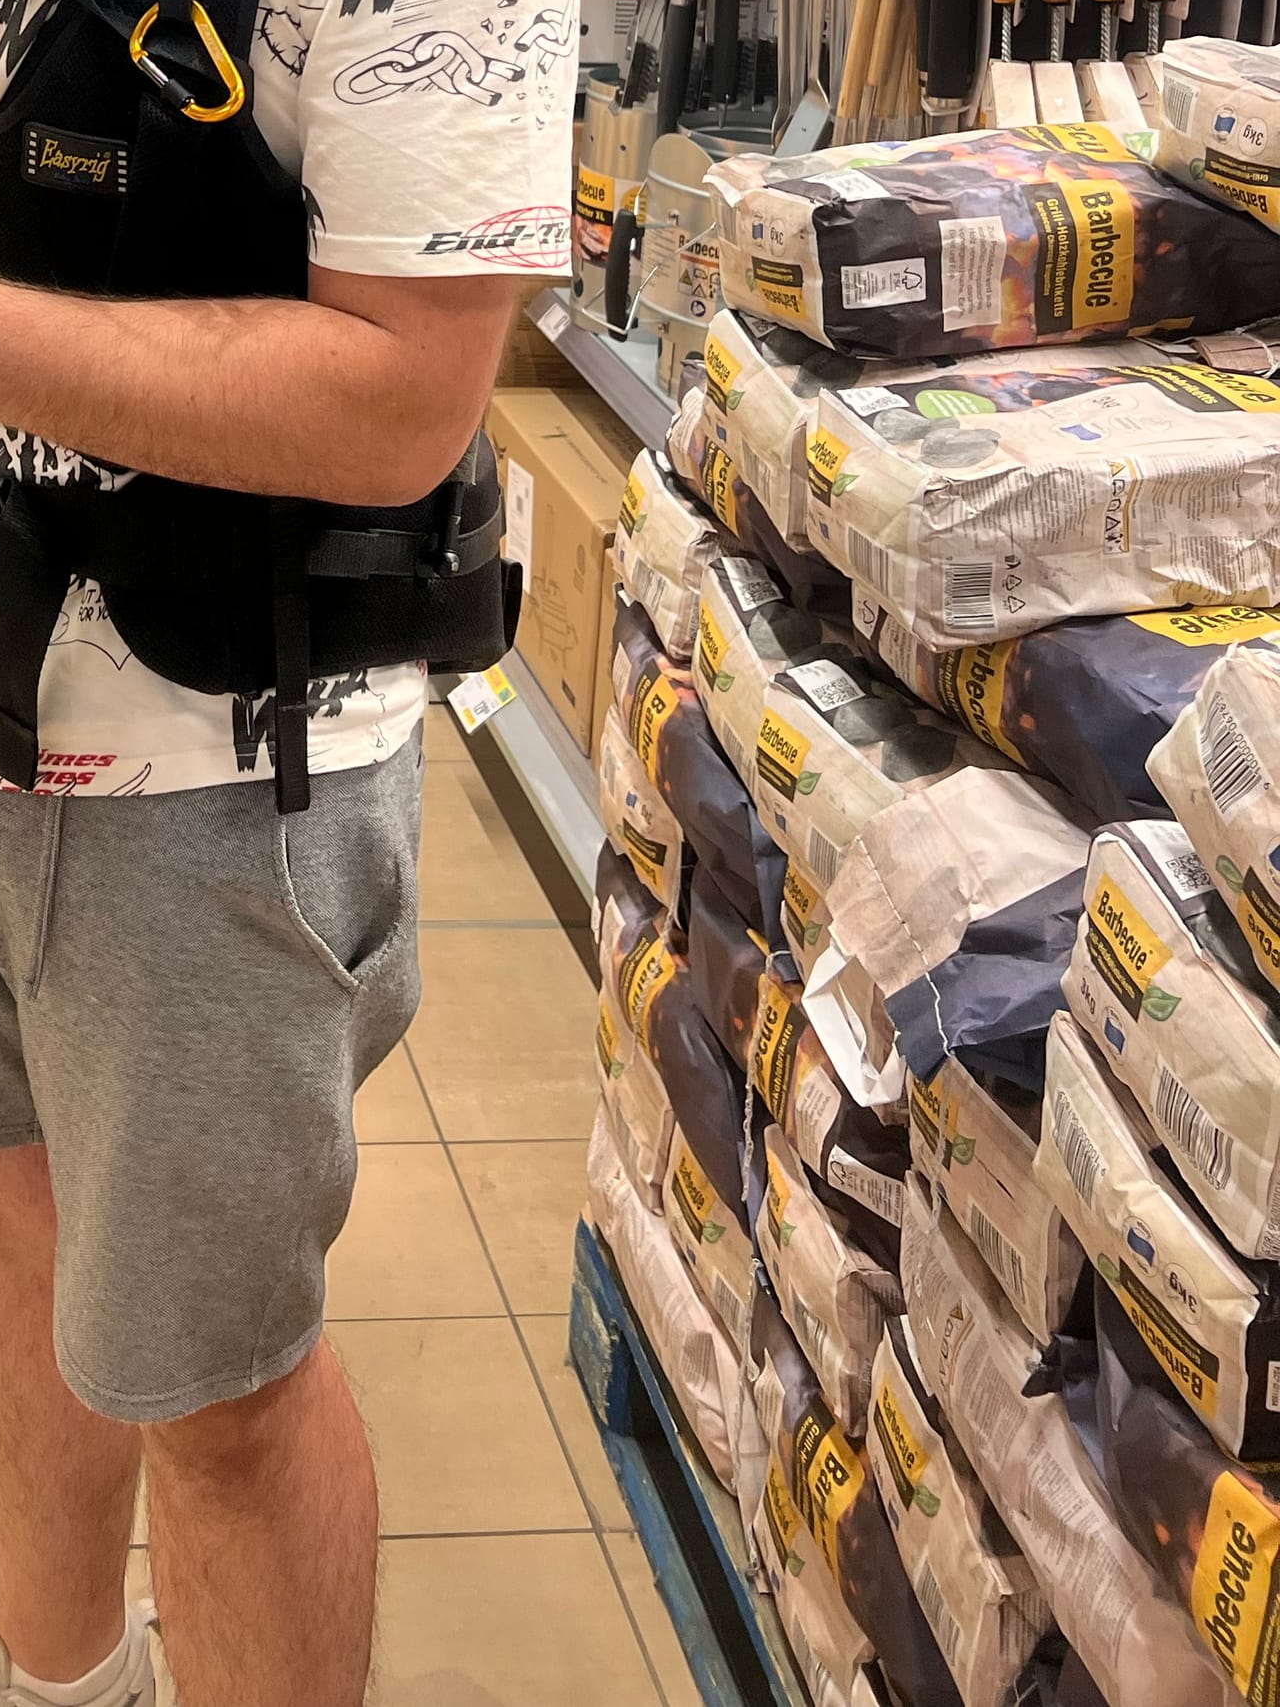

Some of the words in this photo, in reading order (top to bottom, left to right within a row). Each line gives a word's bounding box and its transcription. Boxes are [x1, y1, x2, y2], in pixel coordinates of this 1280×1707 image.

[1242, 123, 1264, 147] 3kg
[39, 137, 111, 183] Easyrig
[1079, 190, 1121, 309] Barbecue
[759, 717, 798, 765] Barbecue
[1096, 890, 1147, 972] Barbecue
[1080, 977, 1096, 1015] 3kg
[1170, 1271, 1198, 1315] 3kg
[1130, 1306, 1204, 1401] Barbecue
